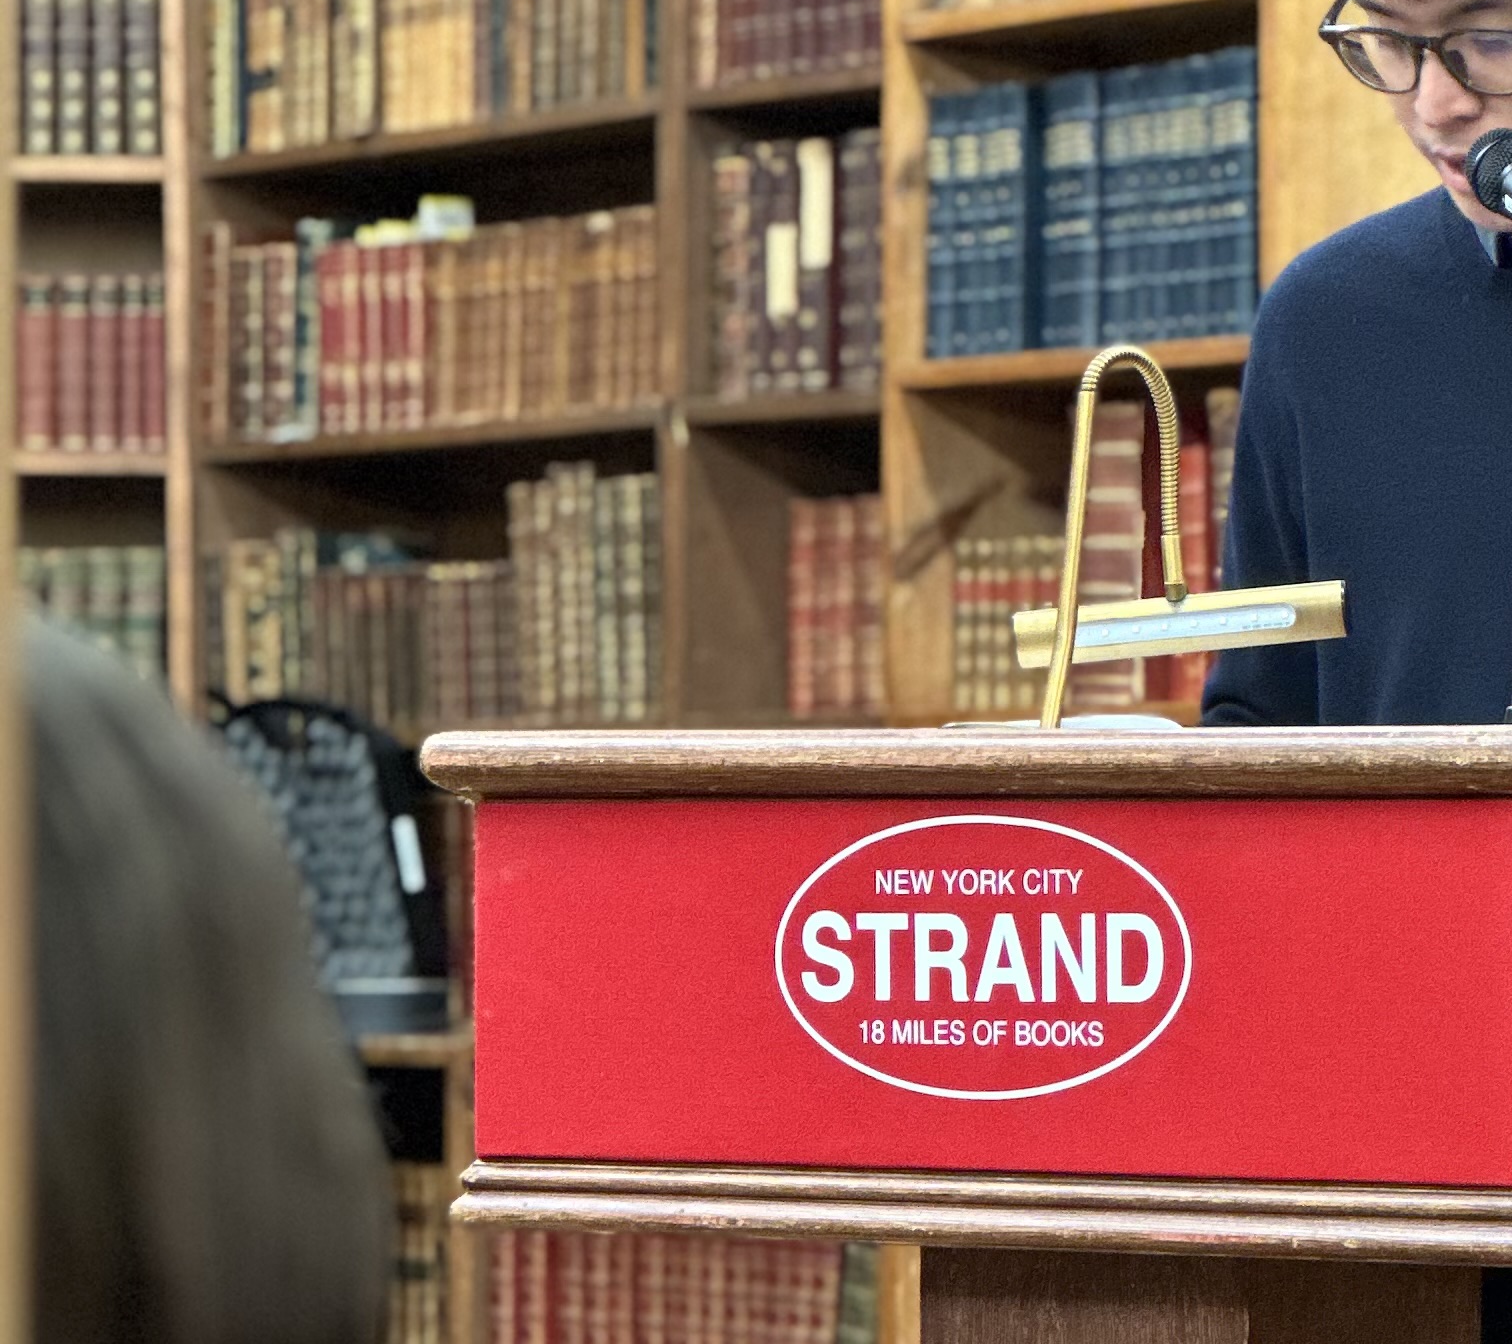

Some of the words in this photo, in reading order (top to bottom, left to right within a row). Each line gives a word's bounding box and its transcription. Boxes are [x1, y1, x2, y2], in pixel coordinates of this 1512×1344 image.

[875, 868, 935, 895] NEW
[941, 868, 1016, 896] YORK
[1022, 868, 1084, 895] CITY
[801, 910, 1164, 1003] STRAND
[858, 1019, 886, 1045] 18
[891, 1018, 966, 1046] MILES
[972, 1019, 1008, 1047] OF
[1014, 1019, 1105, 1047] BOOKS
